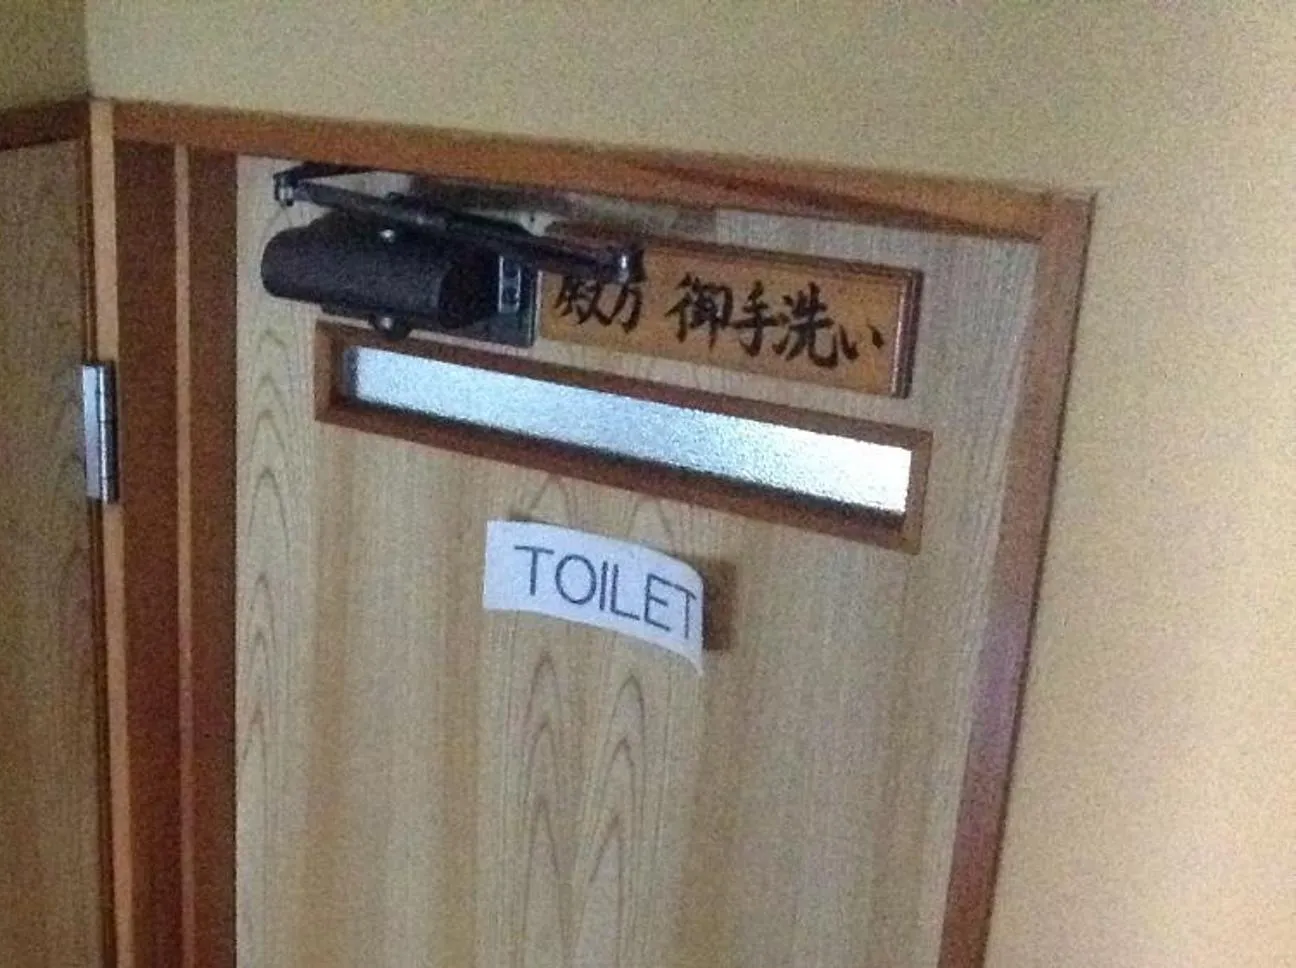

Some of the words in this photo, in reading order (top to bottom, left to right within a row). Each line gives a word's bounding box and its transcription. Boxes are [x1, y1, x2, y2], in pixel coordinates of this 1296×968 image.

[665, 273, 885, 368] 御手洗い
[514, 545, 697, 640] TOILET
